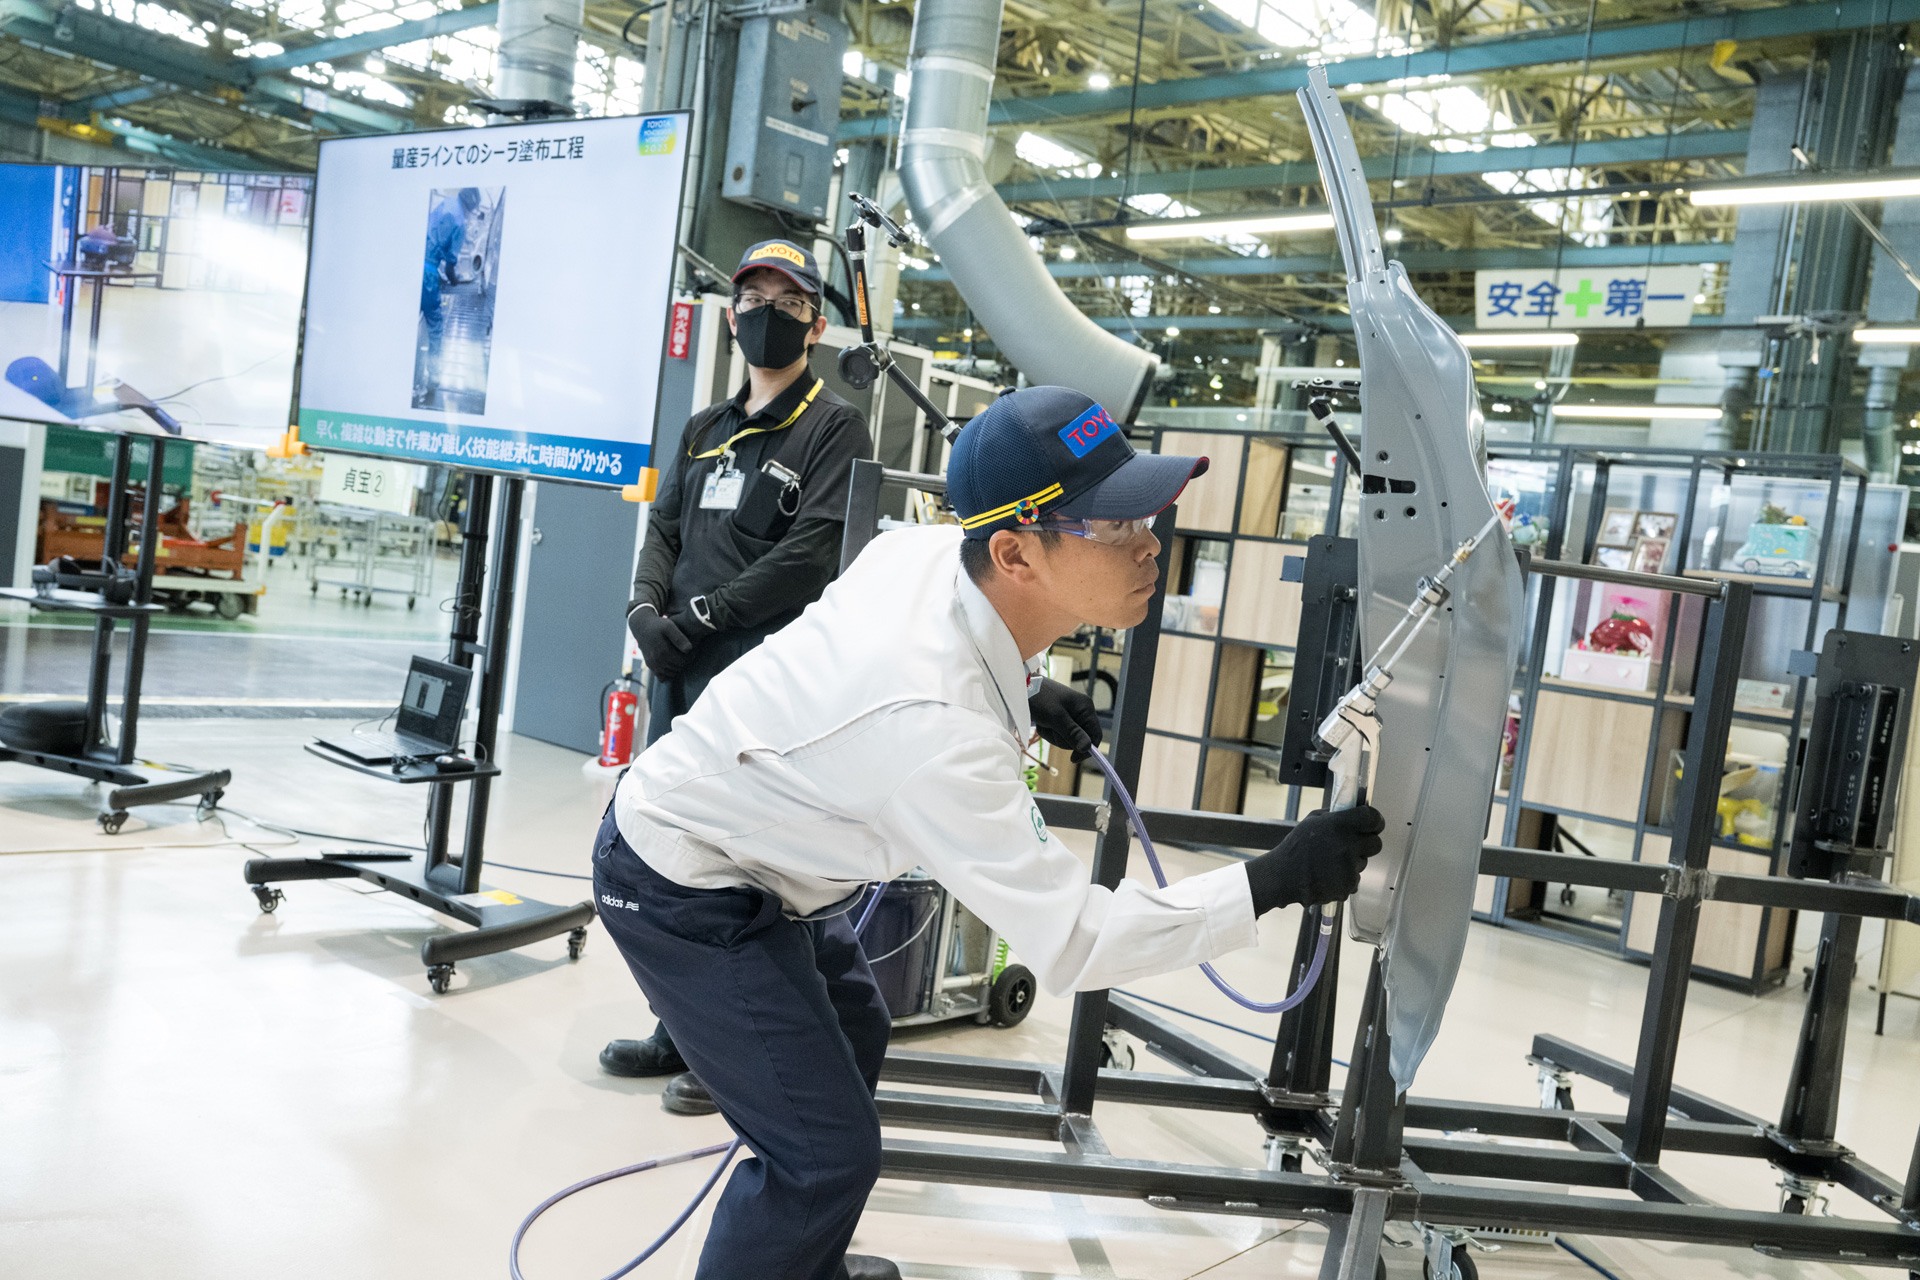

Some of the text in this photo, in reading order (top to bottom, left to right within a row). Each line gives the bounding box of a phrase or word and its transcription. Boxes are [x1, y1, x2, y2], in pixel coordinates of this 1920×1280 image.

[391, 136, 585, 169] 量産ラインでのシーラ塗布工程
[755, 246, 802, 264] TOYOTA
[1487, 279, 1685, 318] 安全 第一
[673, 305, 690, 345] 消火器
[315, 419, 623, 477] 早く、複雑な動きで作業が難しく技能継承に時間がかかる
[601, 894, 624, 909] adidas
